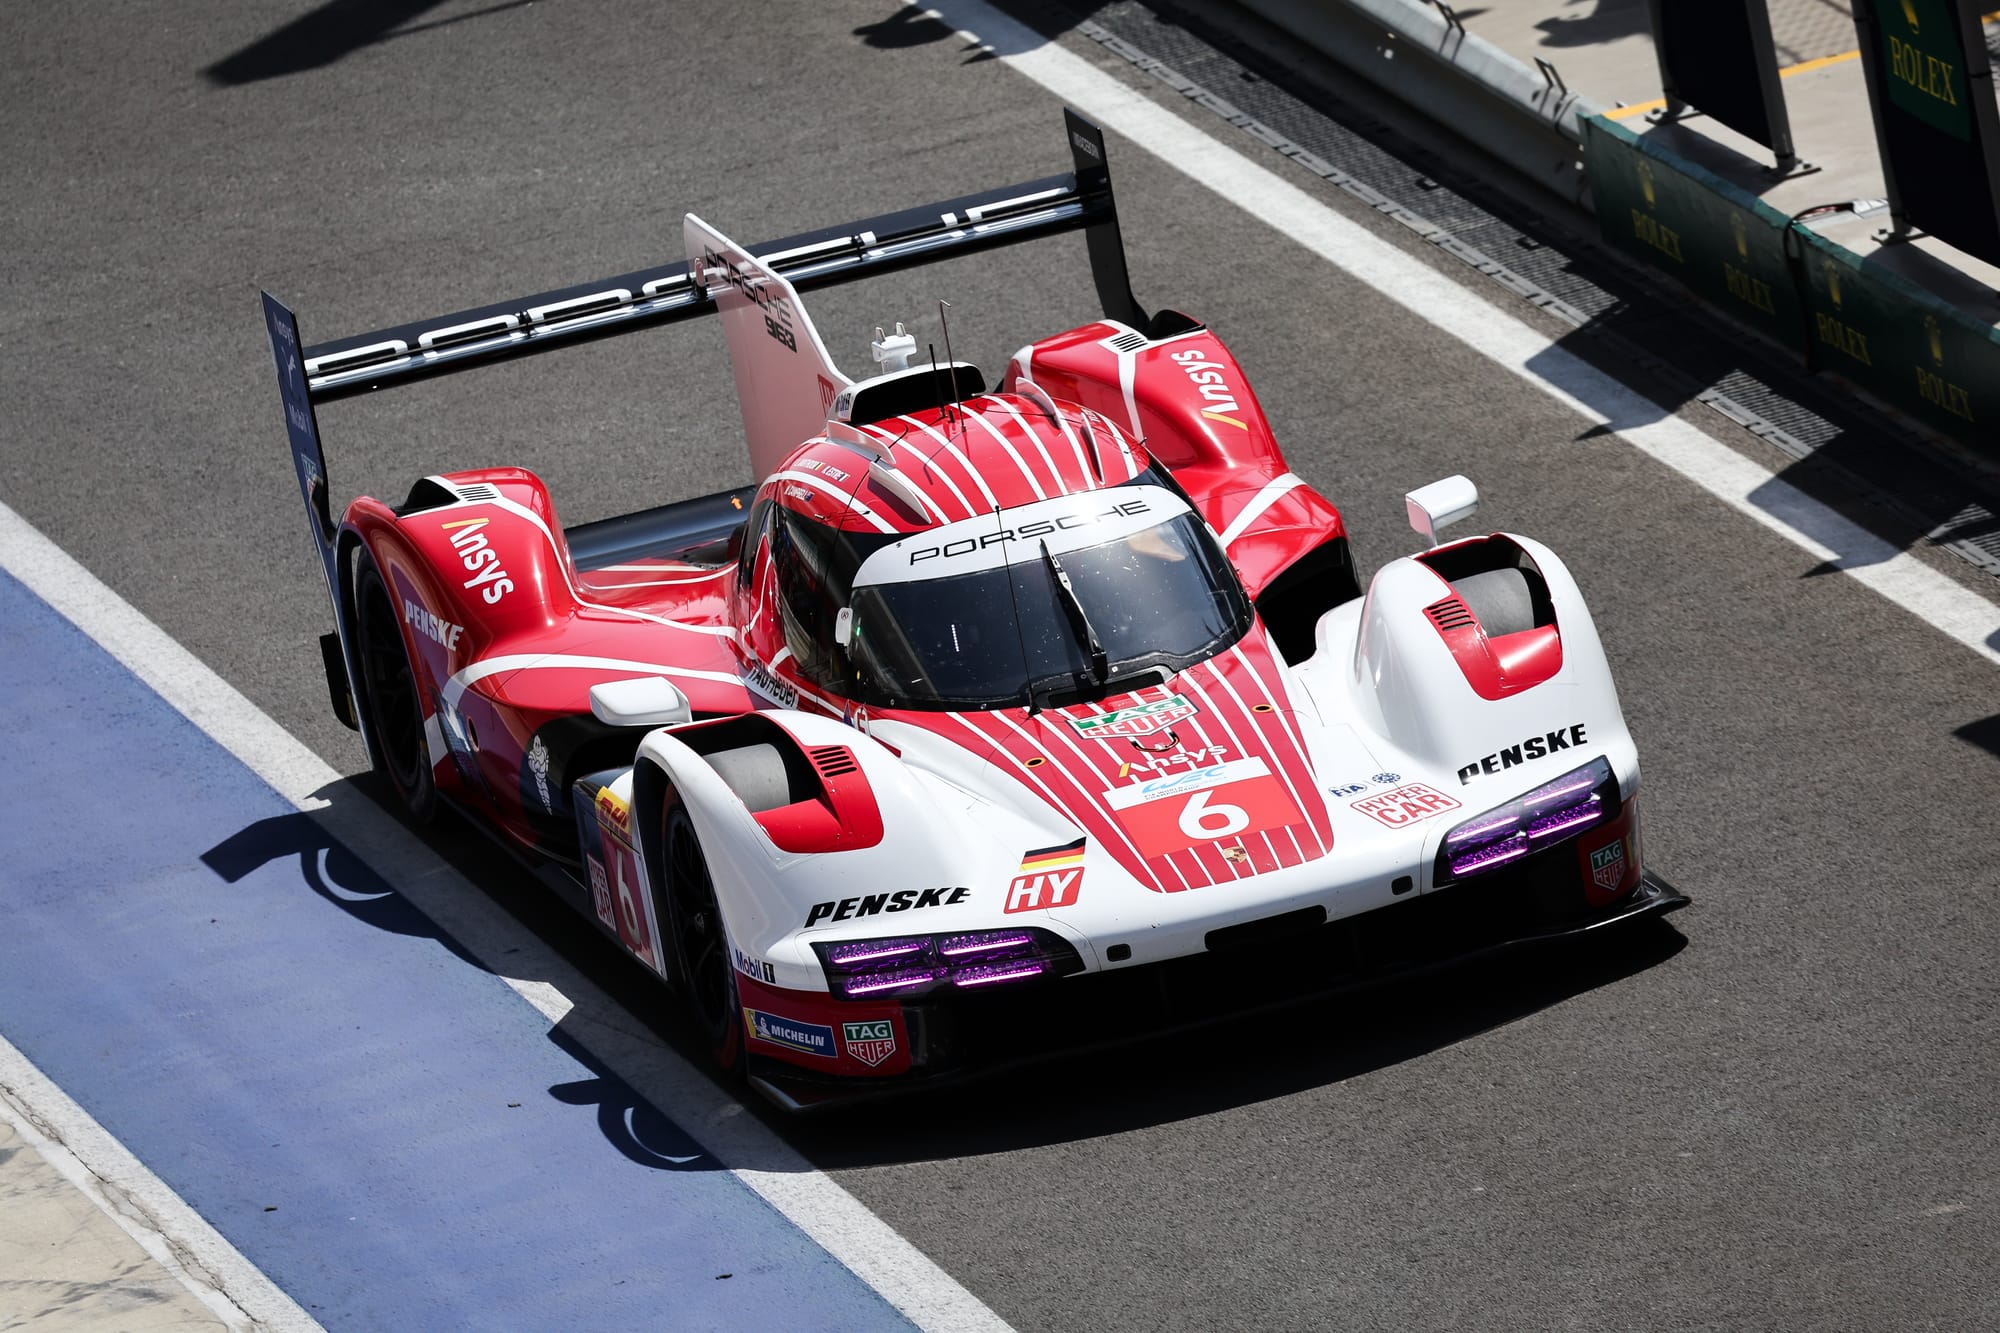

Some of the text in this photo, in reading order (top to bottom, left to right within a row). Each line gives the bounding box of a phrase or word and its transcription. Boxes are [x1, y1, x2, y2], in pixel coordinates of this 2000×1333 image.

[1889, 34, 1957, 106] ROLEX
[1631, 209, 1685, 264] ROLEX
[704, 244, 793, 328] PORSCHE
[1725, 263, 1775, 315] ROLEX
[765, 315, 797, 353] 963
[1816, 313, 1872, 367] ROLEX
[1170, 349, 1249, 431] Ansys
[1915, 366, 1975, 422] ROLEX
[910, 500, 1151, 566] PORSCHE
[441, 517, 514, 605] Ansys
[405, 599, 464, 652] PENSKE
[1080, 700, 1177, 727] TAG
[1085, 706, 1190, 735] HEUER
[1119, 745, 1227, 777] Ansys
[1457, 723, 1588, 785] PENSKE
[1142, 765, 1227, 793] WEC
[1331, 784, 1364, 797] FIA
[1358, 786, 1429, 812] HYPER
[1178, 789, 1250, 840] 6
[1377, 794, 1453, 824] CAR
[1593, 844, 1620, 866] TAG
[1596, 861, 1624, 886] HEUER
[617, 848, 641, 945] 6
[804, 887, 971, 928] PENSKE
[1007, 870, 1081, 911] HY
[735, 949, 763, 980] Mobil
[771, 1024, 825, 1047] MICHELIN
[846, 1024, 888, 1039] TAG
[849, 1041, 892, 1063] HEUER
